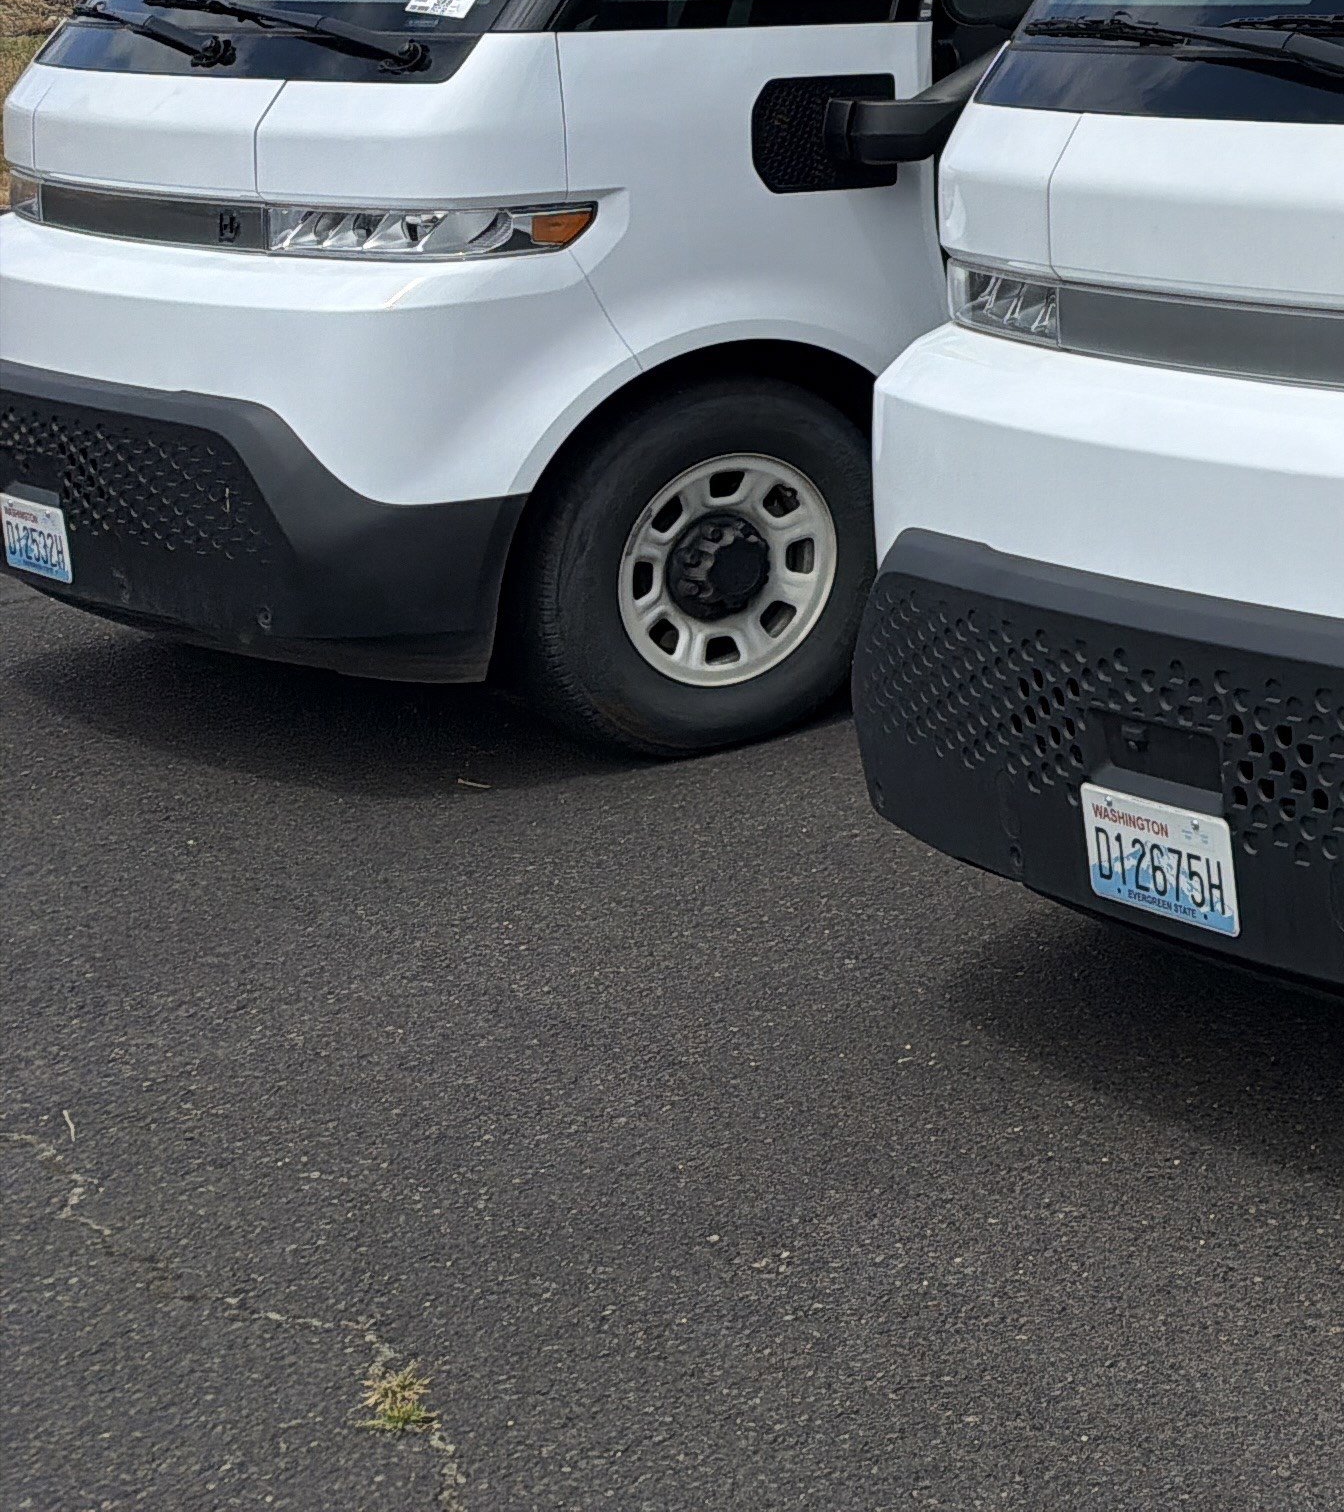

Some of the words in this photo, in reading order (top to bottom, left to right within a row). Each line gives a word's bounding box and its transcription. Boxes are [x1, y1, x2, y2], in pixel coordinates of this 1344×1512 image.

[1092, 803, 1169, 838] WASHINGTON
[1094, 826, 1226, 916] D12675H
[1127, 889, 1172, 912] EVERGREEN
[1173, 902, 1197, 918] STATE
